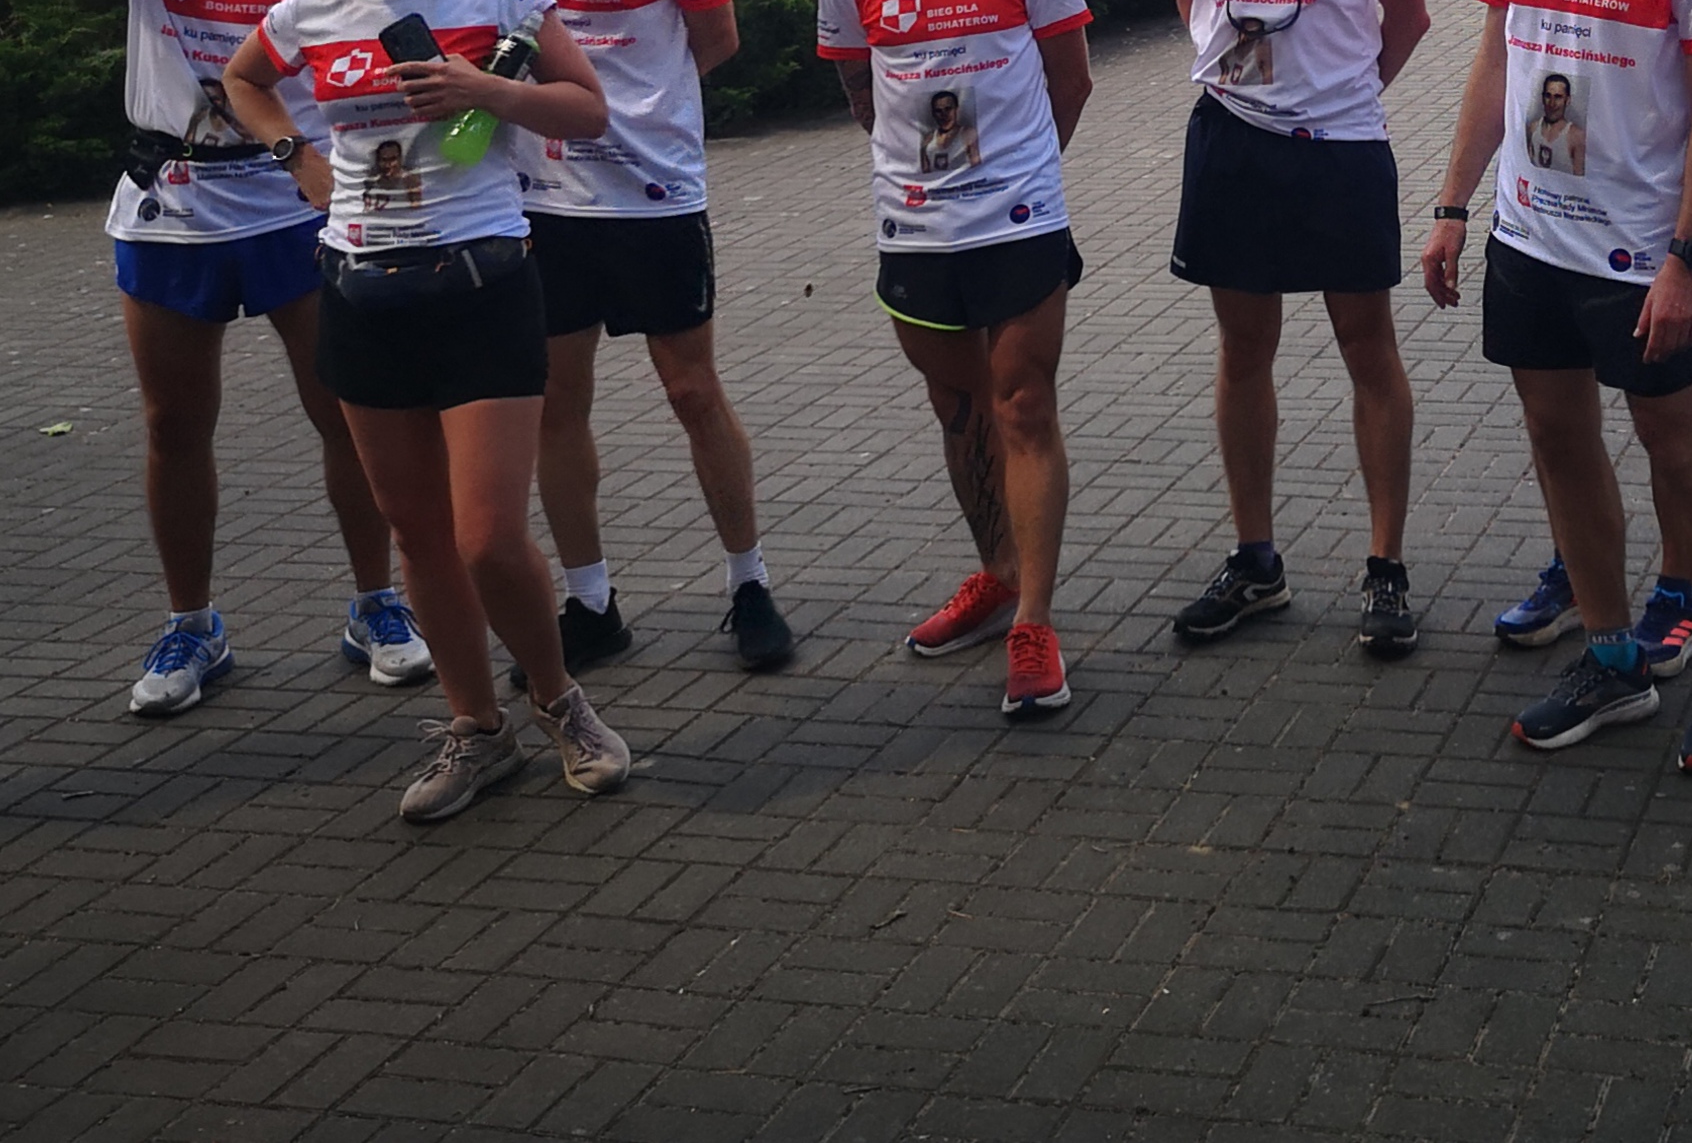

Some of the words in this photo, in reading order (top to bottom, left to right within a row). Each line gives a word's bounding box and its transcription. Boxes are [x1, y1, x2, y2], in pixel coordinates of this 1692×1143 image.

[926, 8, 953, 18] BIEG
[956, 3, 978, 14] DLA
[927, 14, 999, 32] BOHATERÓW
[1541, 19, 1552, 31] ku
[183, 26, 198, 39] ku
[929, 44, 967, 60] pamięci
[1545, 44, 1636, 68] Kusocińskiego
[924, 57, 1009, 79] Kusocińskiego
